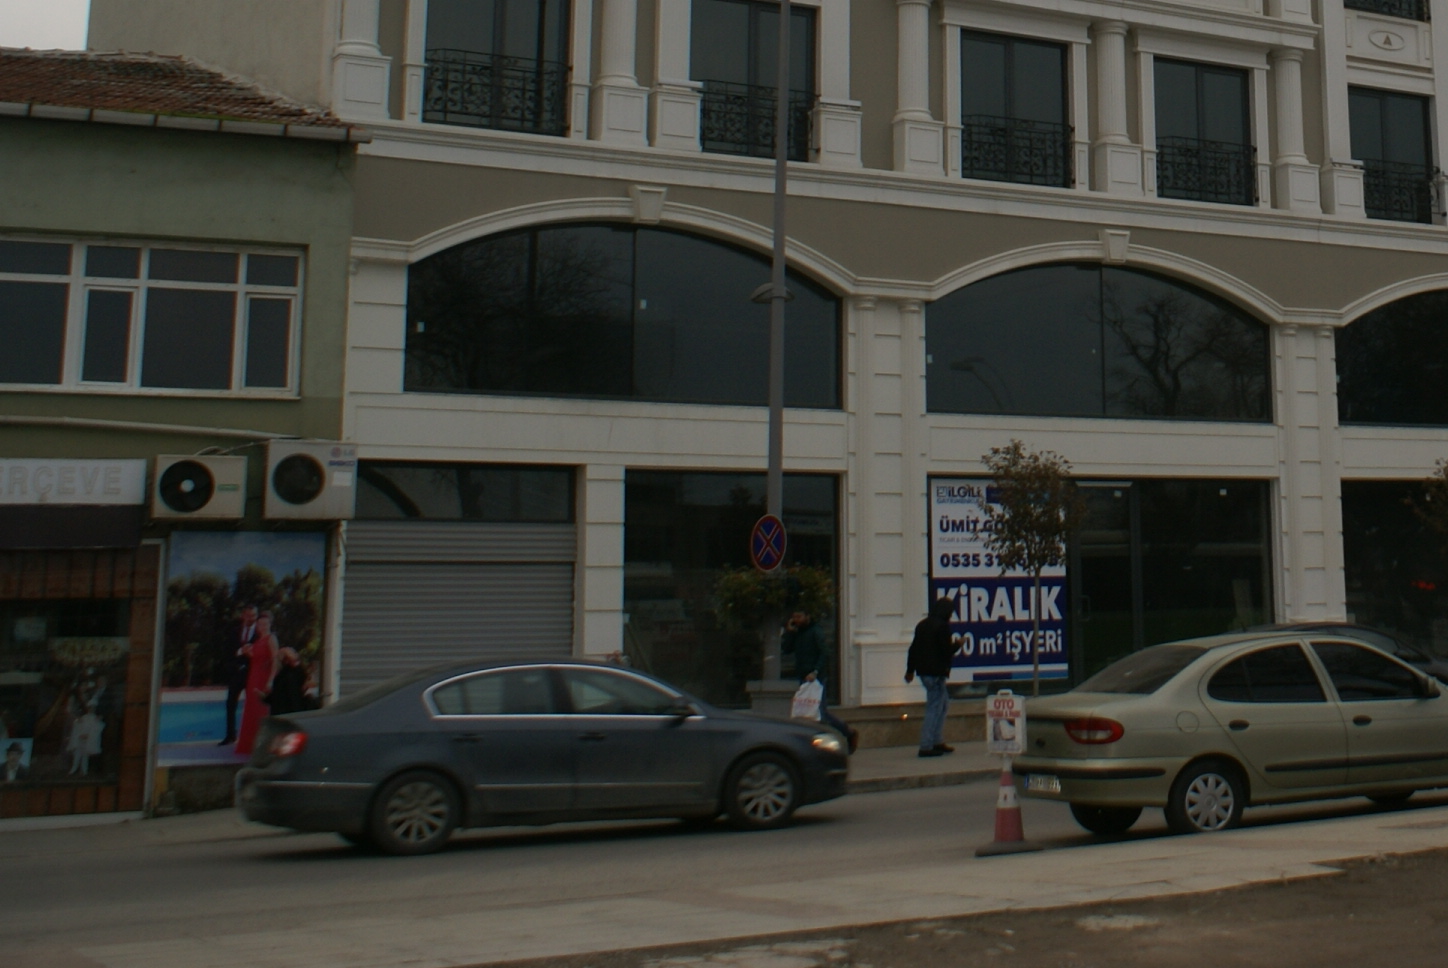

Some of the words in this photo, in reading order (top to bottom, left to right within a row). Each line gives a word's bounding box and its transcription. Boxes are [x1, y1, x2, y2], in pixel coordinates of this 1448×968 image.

[0, 467, 122, 502] RÇEVE
[940, 515, 979, 533] ÜMİT
[940, 553, 980, 567] 0535
[994, 698, 1014, 710] OTO
